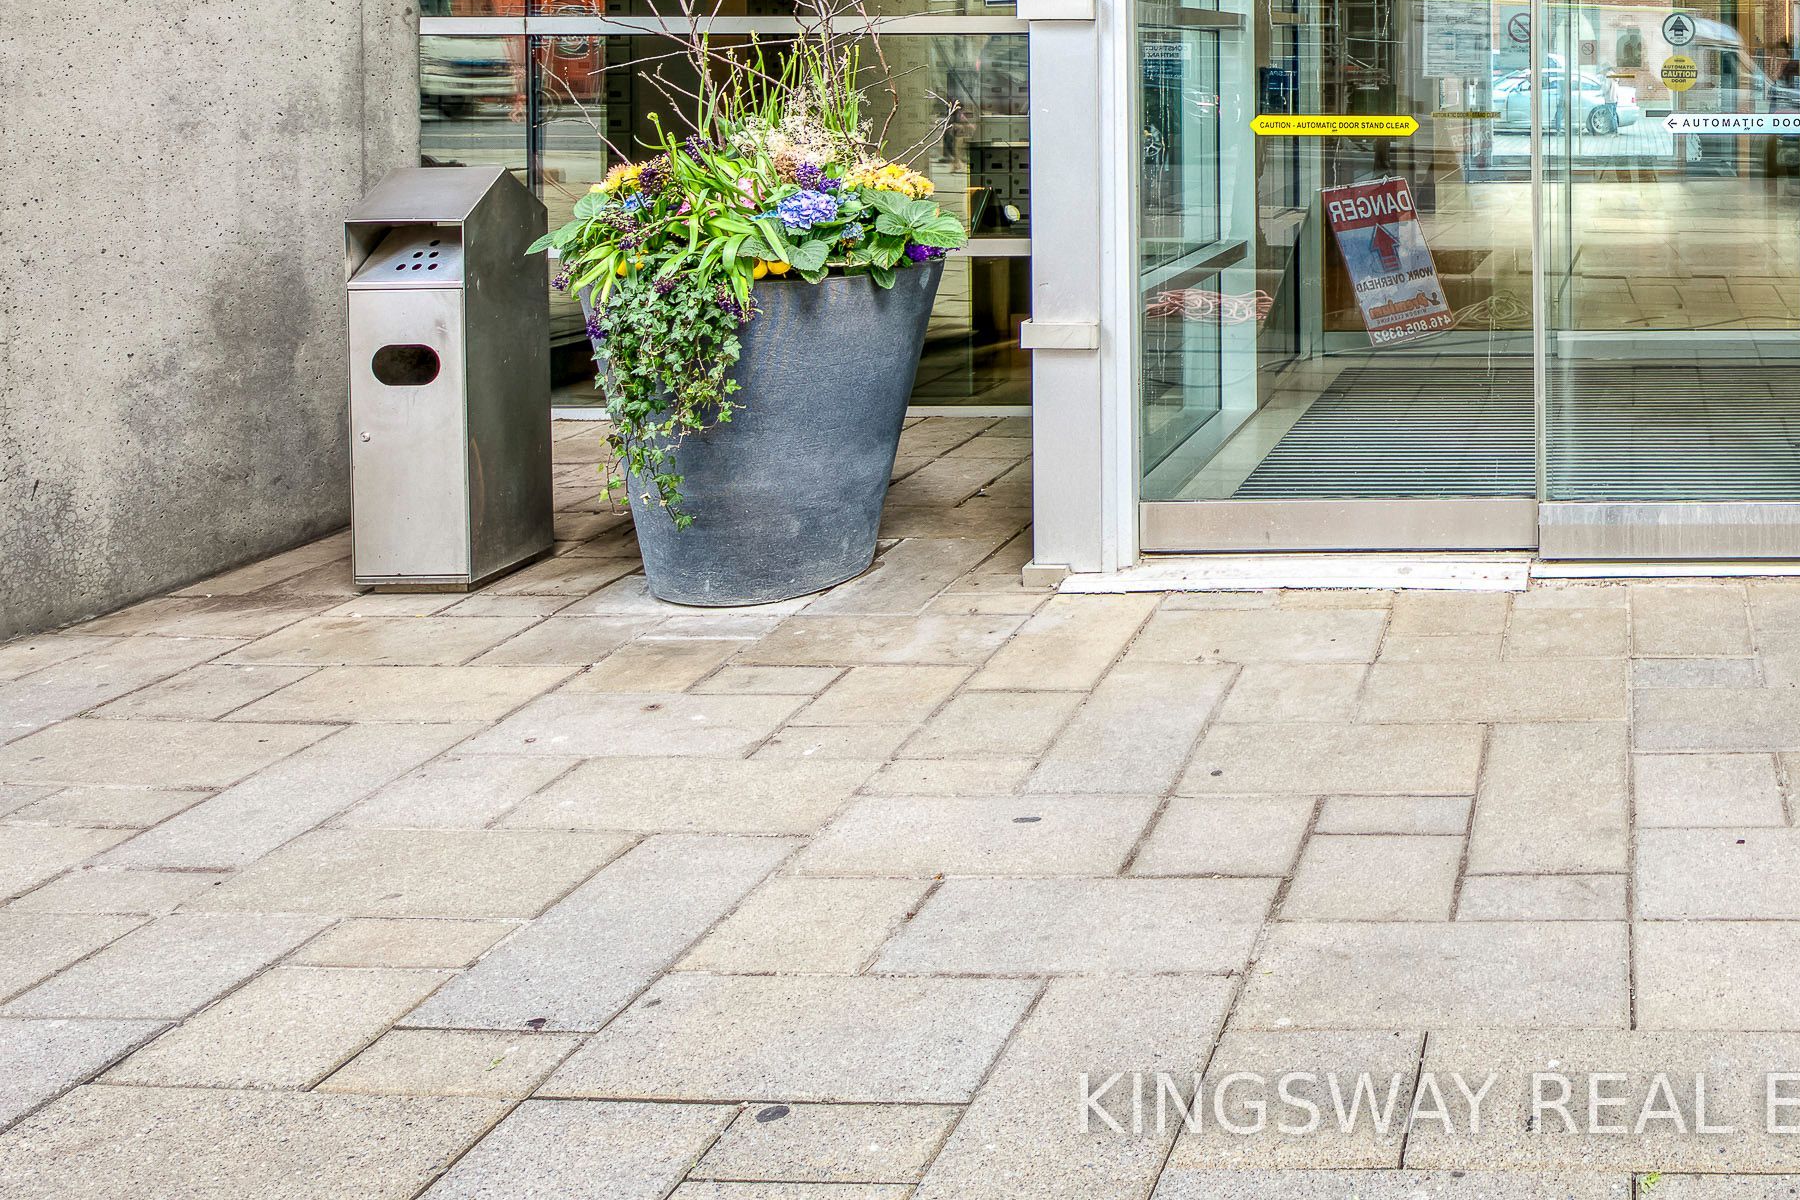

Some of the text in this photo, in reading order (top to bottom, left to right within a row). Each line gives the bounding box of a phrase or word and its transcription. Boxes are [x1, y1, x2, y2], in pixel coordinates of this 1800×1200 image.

[1662, 70, 1697, 78] CAUTION
[1259, 121, 1291, 129] CAUTION
[1296, 121, 1337, 129] AUTOMATIC
[1338, 121, 1359, 129] DOOR
[1361, 121, 1385, 129] STAND
[1386, 121, 1410, 129] CLEAR
[1682, 118, 1764, 127] AUTOMATIC
